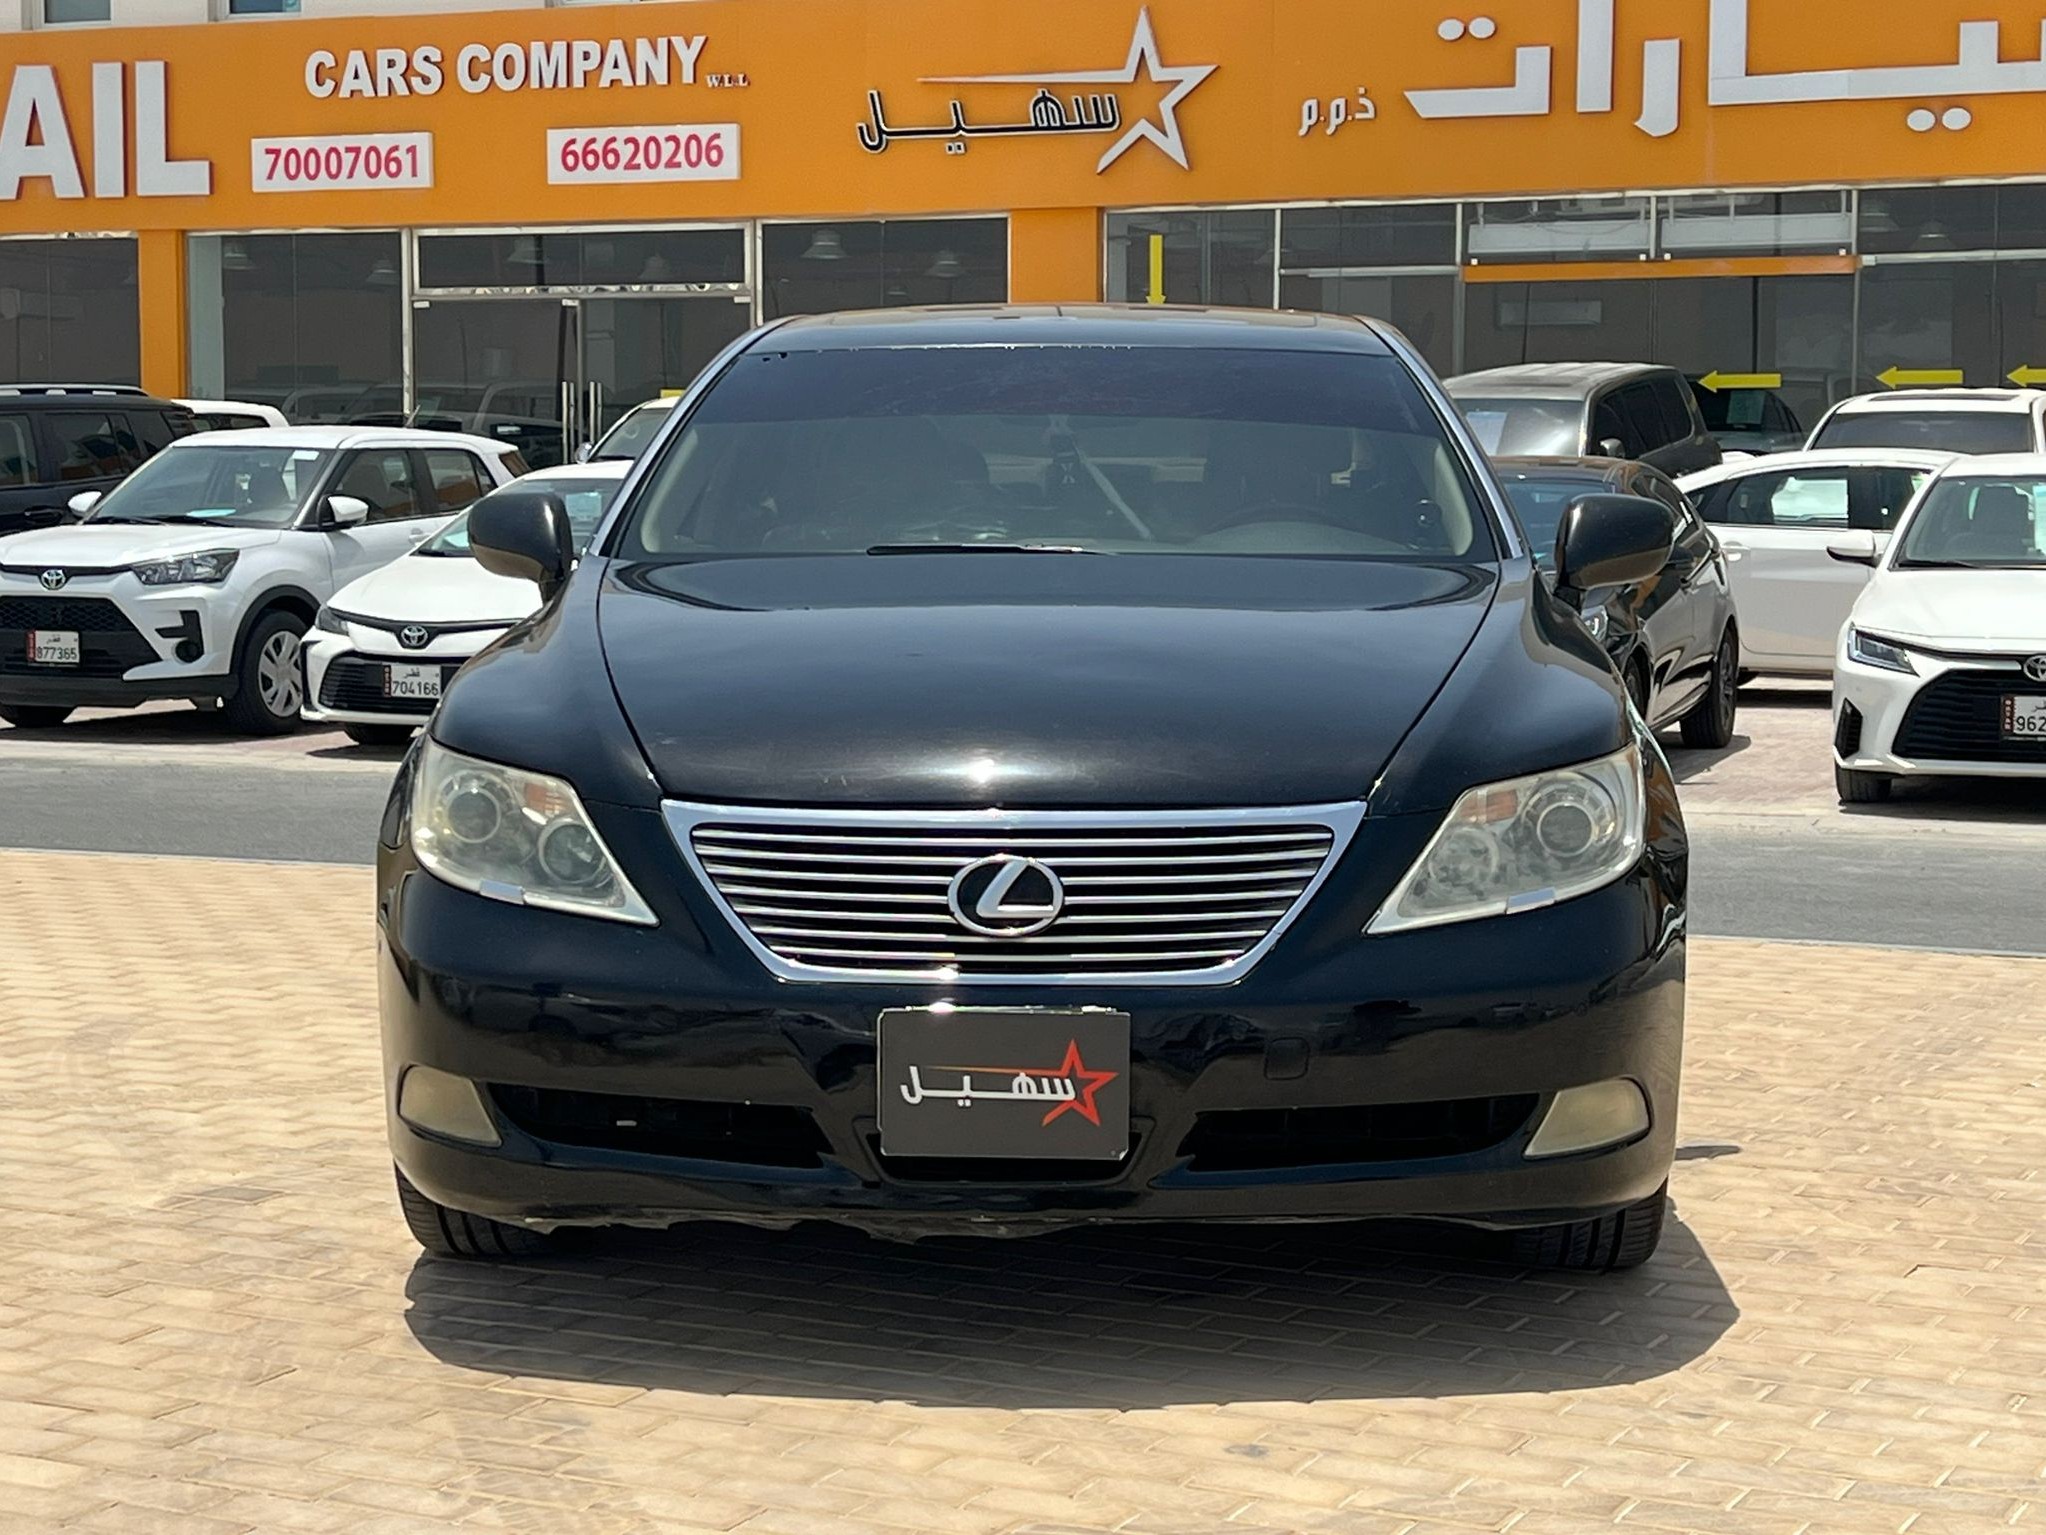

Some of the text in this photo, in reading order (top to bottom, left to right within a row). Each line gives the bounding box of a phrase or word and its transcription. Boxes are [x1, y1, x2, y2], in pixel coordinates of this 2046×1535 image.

[305, 46, 444, 99] CARS
[456, 35, 707, 93] COMPANY
[1404, 0, 2046, 137] يارات
[856, 88, 1122, 155] سهيل
[264, 144, 419, 182] 70007061
[560, 132, 724, 172] 66620206
[36, 646, 78, 660] 877365
[392, 680, 439, 696] 704166
[900, 1065, 1076, 1107] سهيل
